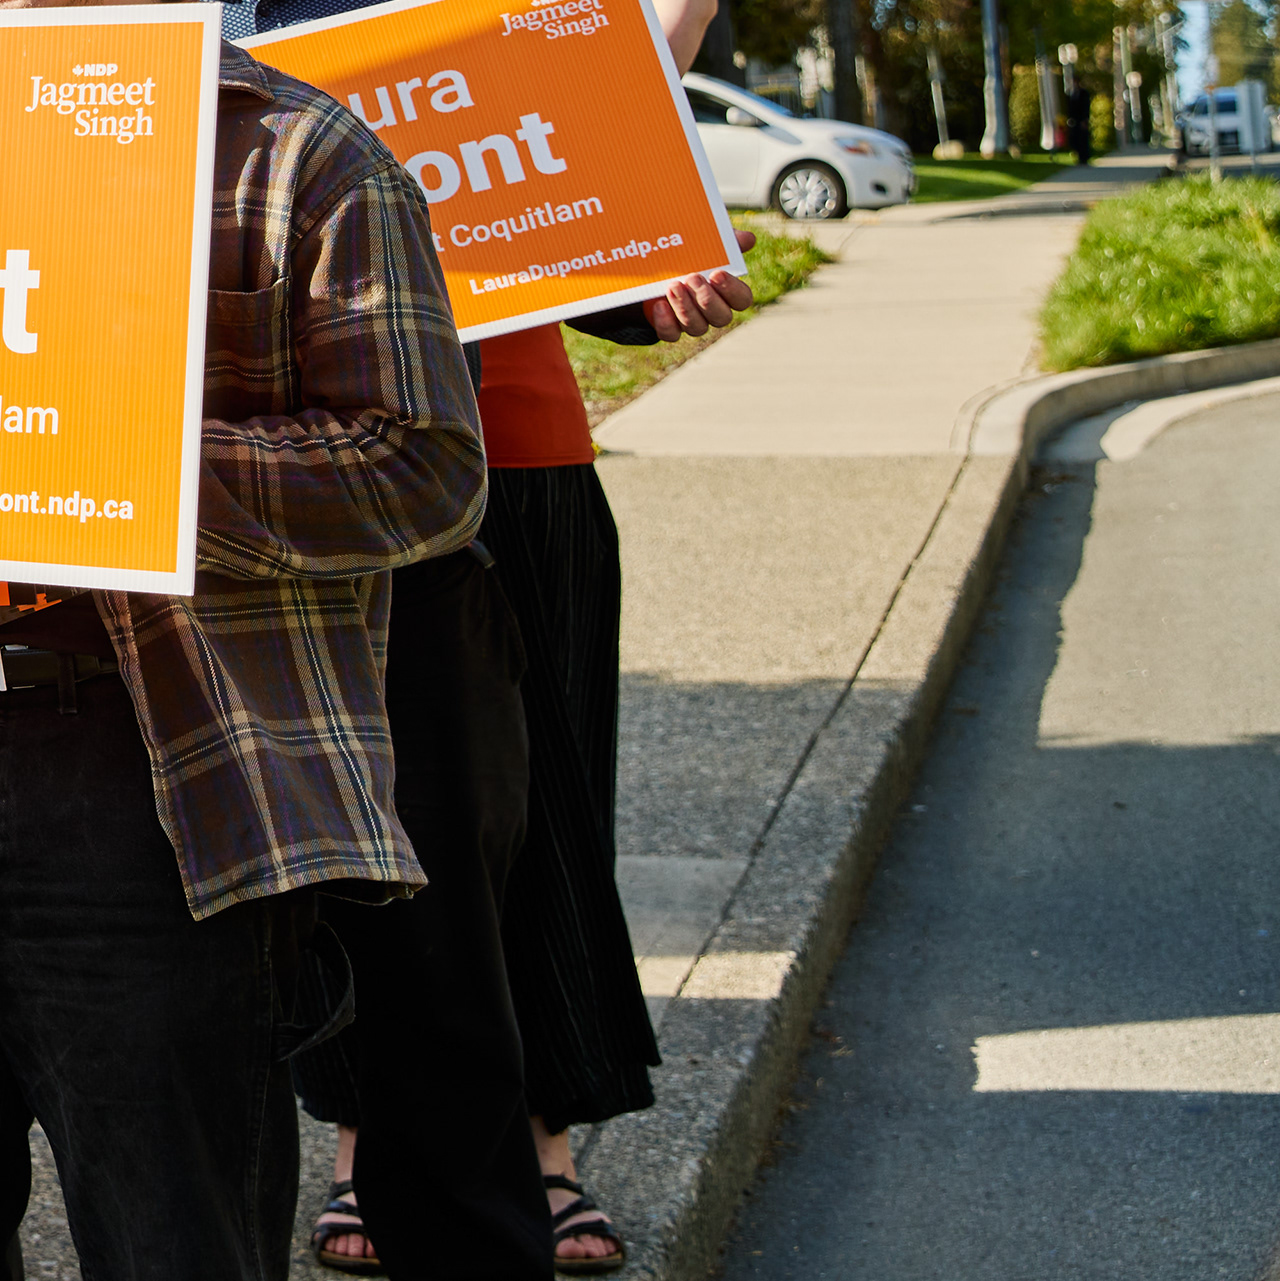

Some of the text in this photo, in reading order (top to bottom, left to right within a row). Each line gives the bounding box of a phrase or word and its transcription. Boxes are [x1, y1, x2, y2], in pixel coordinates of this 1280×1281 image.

[545, 11, 610, 41] Singh
[84, 64, 119, 76] NDP
[25, 75, 156, 115] Jagmeet
[348, 68, 475, 131] ura
[74, 107, 154, 145] Singh
[404, 112, 568, 204] ont
[449, 195, 604, 248] Coquitlam
[469, 231, 684, 296] LauraDupont.ndp.ca
